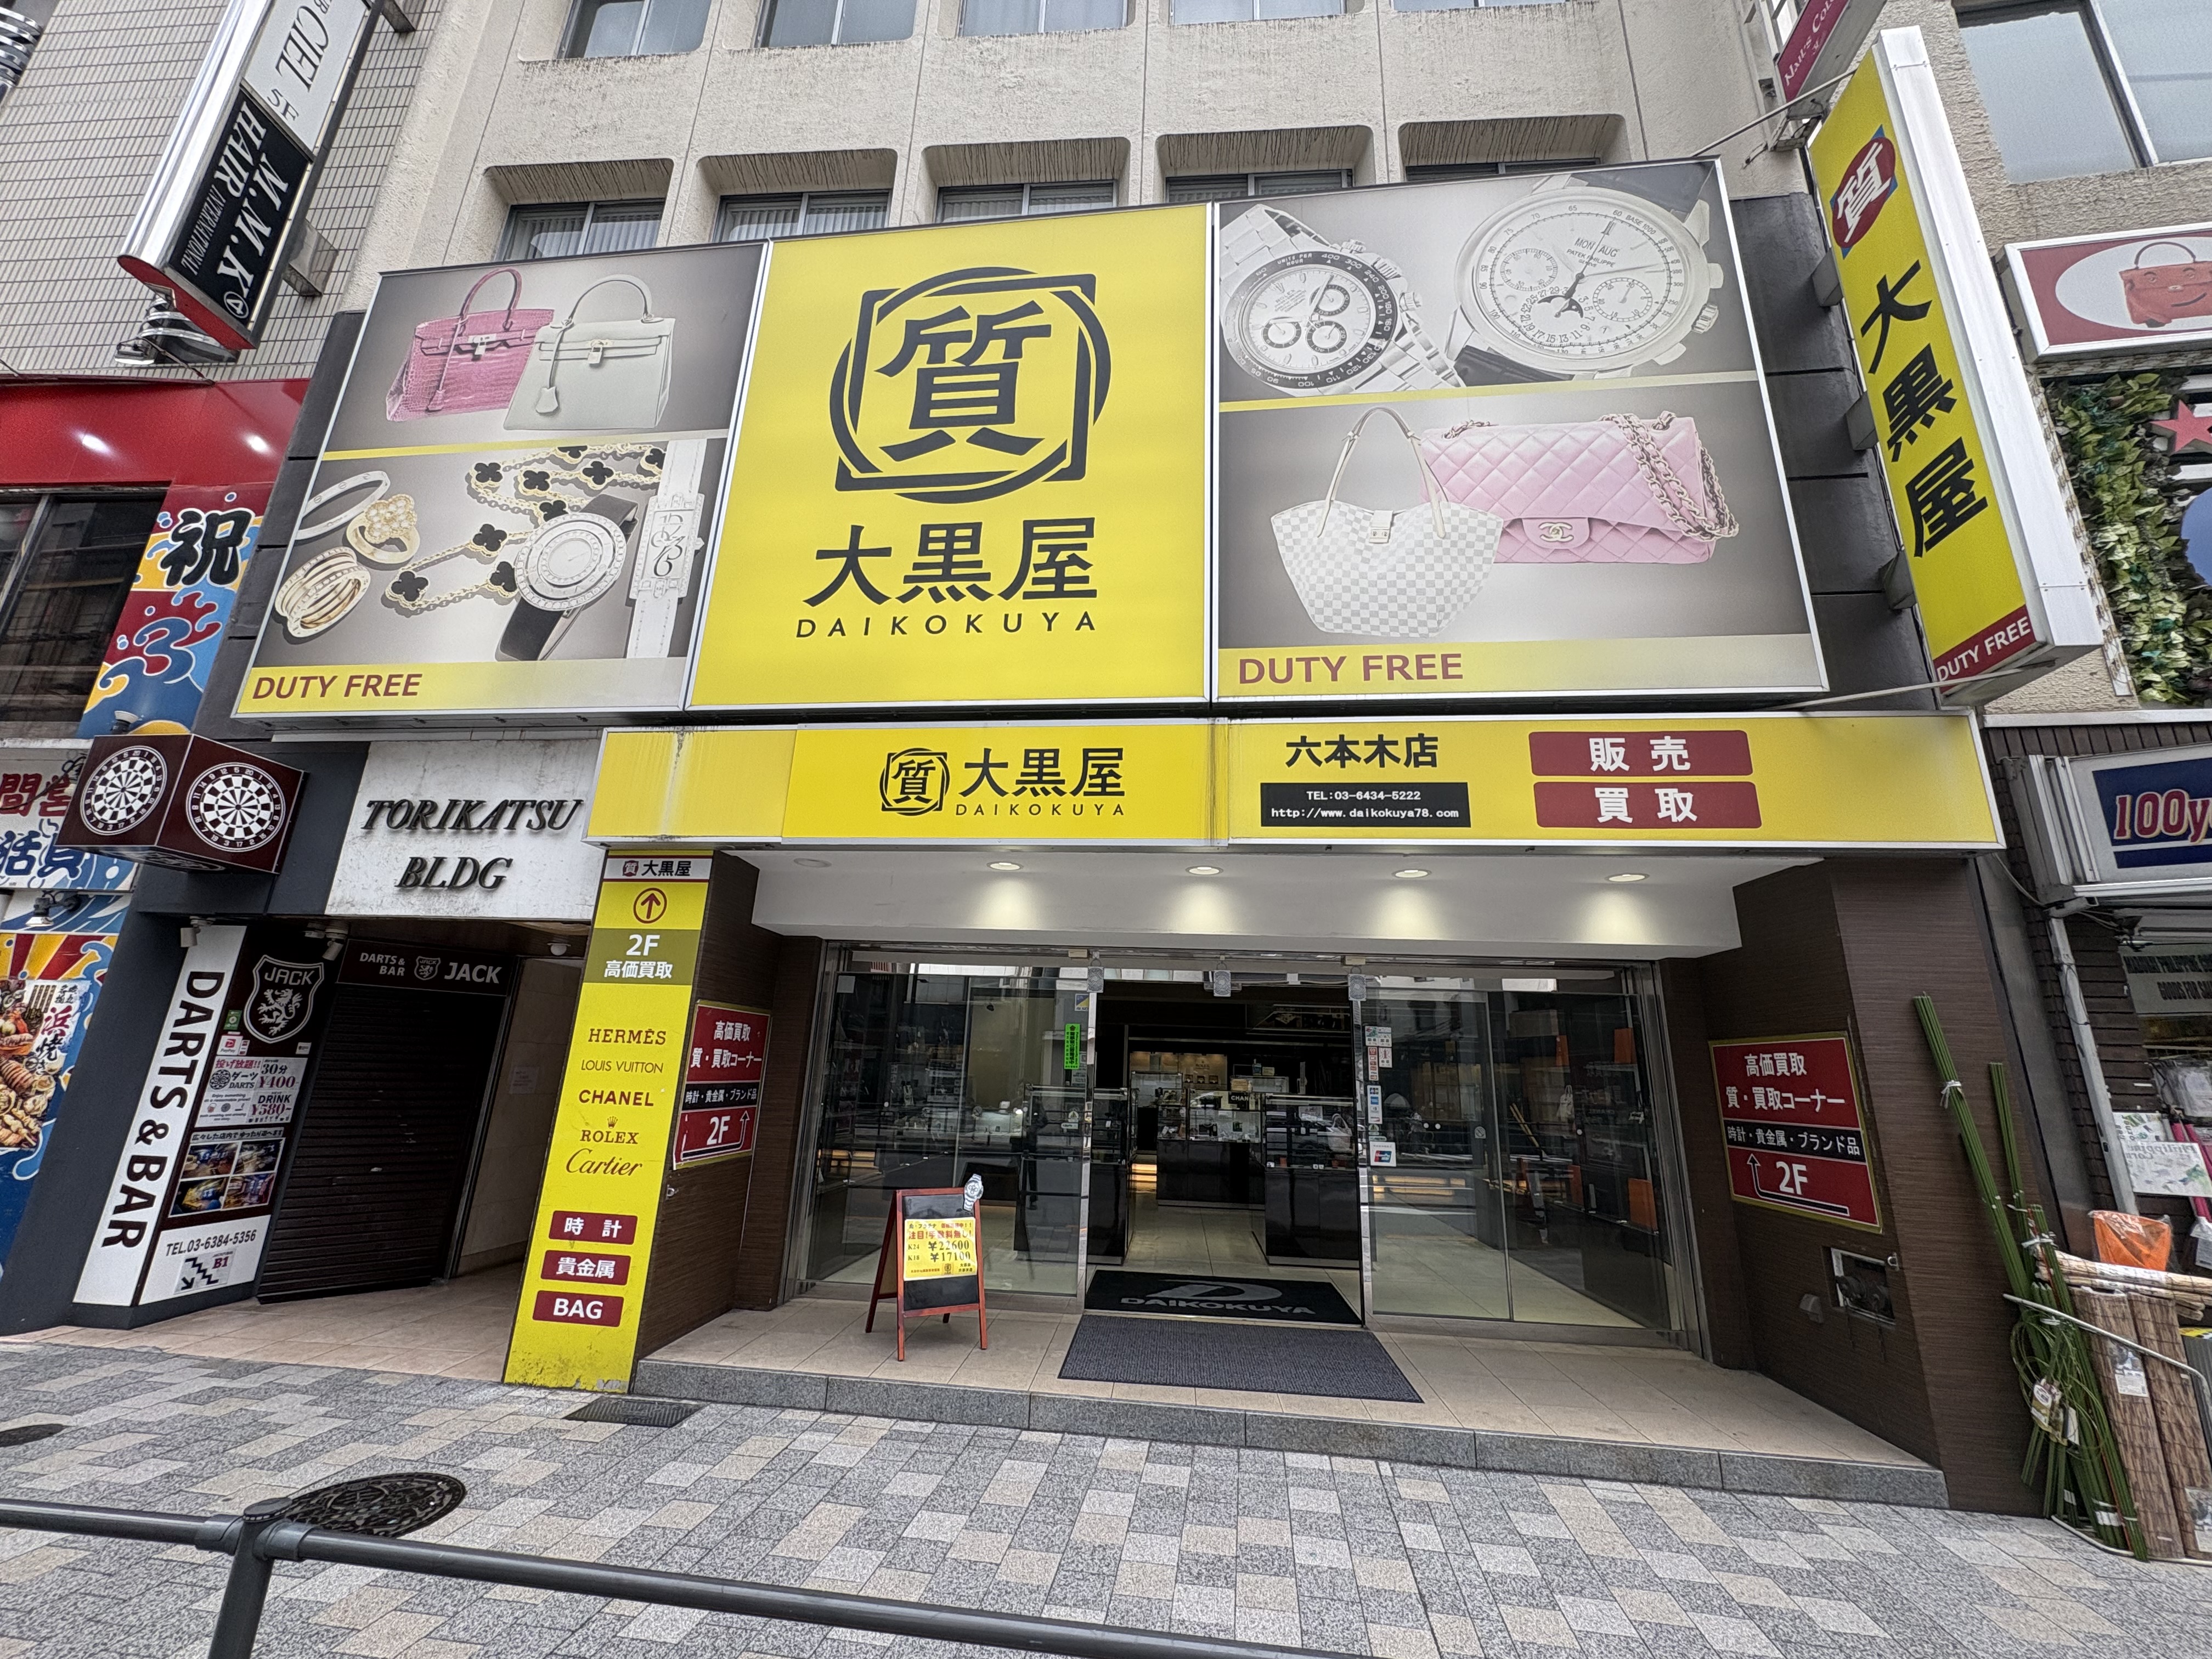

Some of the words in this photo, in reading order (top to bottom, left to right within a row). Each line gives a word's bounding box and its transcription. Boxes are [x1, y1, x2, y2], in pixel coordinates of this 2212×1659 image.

[275, 5, 329, 93] CIEL
[214, 101, 266, 198] HAIR
[180, 184, 227, 275] INTERNATIONAL
[1567, 249, 1586, 260] PATEK
[1575, 238, 1595, 251] MON
[1598, 245, 1618, 257] AUG
[1277, 255, 1296, 265] UNITS
[1345, 259, 1362, 269] 300
[1364, 269, 1380, 283] 240
[1378, 285, 1389, 299] 200
[873, 300, 1051, 462] 質
[1860, 259, 1989, 558] 大黒屋
[161, 509, 253, 586] 祝
[802, 517, 1098, 607] 大黒屋
[795, 611, 1096, 639] DAIKOKUYA
[1936, 645, 1980, 682] DUTY
[1984, 615, 2031, 657] FREE
[1239, 656, 1347, 684] DUTY
[1362, 653, 1464, 681] FREE
[252, 675, 338, 699] DUTY
[343, 674, 423, 698] FREE
[1285, 733, 1438, 769] 六本木店
[1589, 736, 1691, 772] 販売
[891, 758, 936, 804] 質
[958, 747, 1125, 798] 大黒屋
[1306, 791, 1421, 801] TEL:03-6434-5222
[1594, 787, 1697, 823] 買取
[361, 798, 584, 831] TORIKATSU
[955, 803, 1124, 816] DAIKOKUYA
[1271, 807, 1459, 819] http://www.daikokuya78.com
[2114, 789, 2212, 844] 100y
[394, 856, 514, 890] BLDG
[641, 860, 692, 877] 大黒屋
[626, 934, 660, 956] 2F
[359, 952, 398, 964] DARTS
[264, 970, 315, 986] JACK
[379, 966, 405, 977] BAR
[444, 962, 503, 984] JACK
[604, 960, 673, 979] 高価買取
[150, 971, 224, 1110] DARTS
[588, 1028, 667, 1046] HERMÈS
[713, 1020, 752, 1042] 高価買取
[261, 1063, 288, 1075] 30分
[581, 1059, 612, 1072] LOUIS
[616, 1060, 663, 1074] VUITTON
[691, 1047, 762, 1069] 質・買取コーナー
[1743, 1052, 1808, 1077] 高価買取
[232, 1071, 259, 1081] ダーツ
[257, 1094, 292, 1104] DRINK
[578, 1090, 654, 1107] CHANEL
[685, 1088, 757, 1104] 時計・貴金属・ブランド品
[1725, 1086, 1846, 1113] 質・買取コーナー
[136, 1119, 169, 1146] &
[579, 1130, 640, 1146] ROLEX
[707, 1115, 731, 1146] 2F
[1727, 1126, 1861, 1155] 時計・貴金属・ブランド品
[566, 1148, 643, 1177] Cartier
[1776, 1161, 1808, 1195] 2F
[101, 1155, 168, 1249] BAR
[564, 1217, 622, 1239] 時計
[166, 1229, 257, 1256] TEL.03-6384-5356
[212, 1256, 229, 1269] B1
[556, 1257, 616, 1279] 貴金属
[552, 1298, 603, 1320] BAG
[1119, 1297, 1316, 1314] DAIKOKUYA
